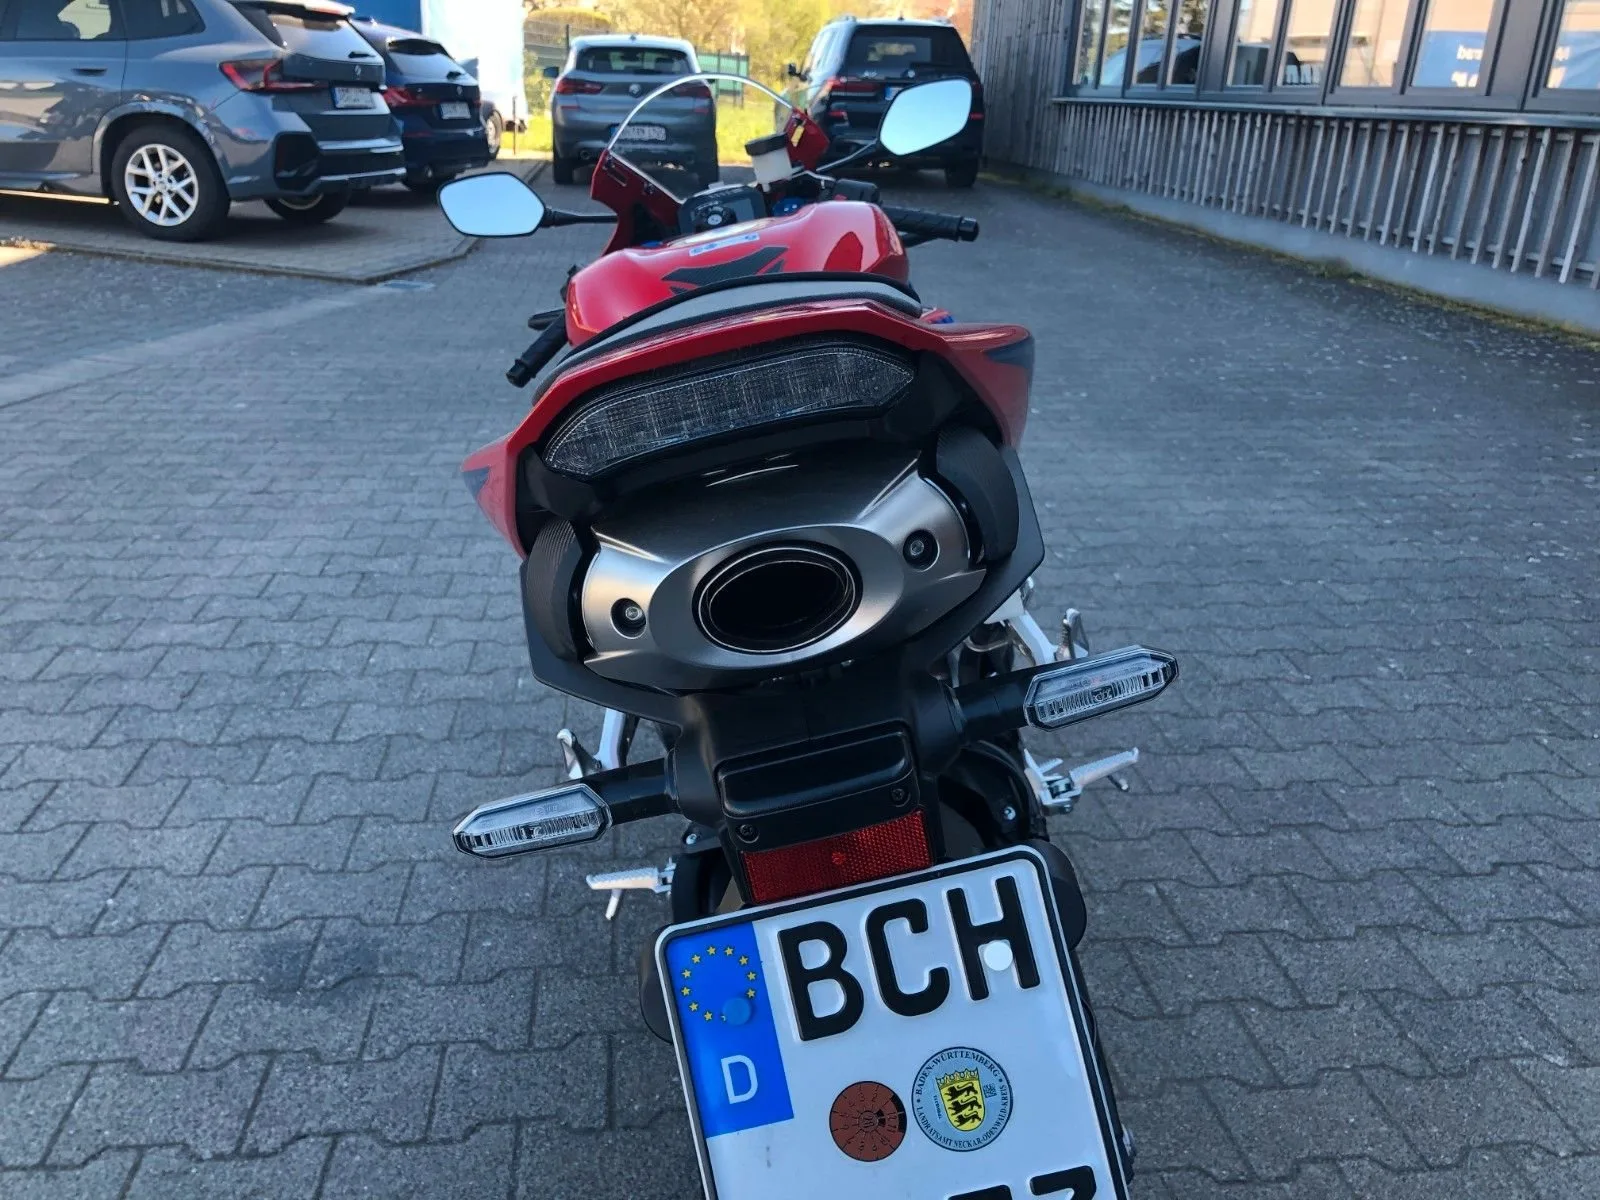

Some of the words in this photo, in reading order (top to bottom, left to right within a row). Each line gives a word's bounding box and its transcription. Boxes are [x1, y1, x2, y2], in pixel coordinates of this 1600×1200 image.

[777, 876, 1040, 1041] BCH
[720, 1054, 758, 1104] D
[916, 1050, 1000, 1096] BADEN-WÜRTTEMBERG
